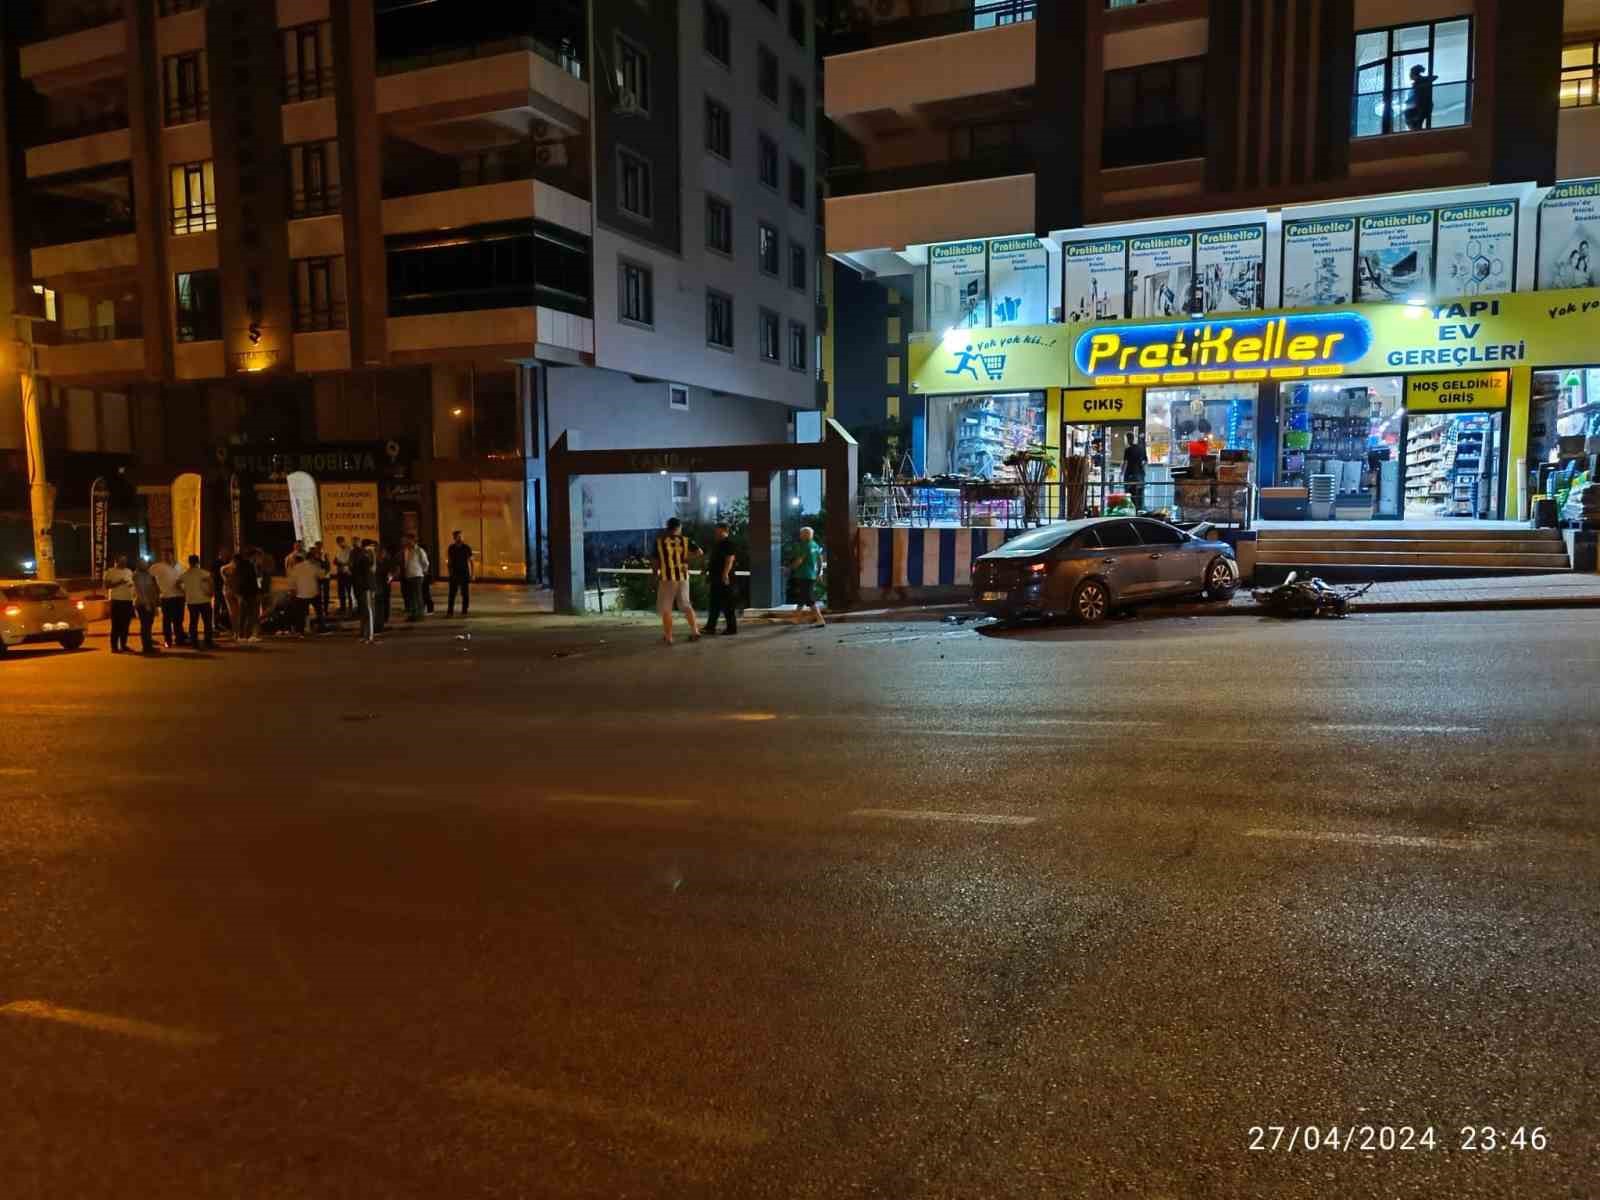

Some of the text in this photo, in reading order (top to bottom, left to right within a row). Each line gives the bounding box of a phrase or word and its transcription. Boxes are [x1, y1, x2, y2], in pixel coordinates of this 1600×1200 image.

[1444, 205, 1509, 220] Pratikeller
[1364, 213, 1428, 228] Pratikeller
[1290, 222, 1350, 235] Pratikeller
[1133, 236, 1188, 250] Pratikeller
[1202, 230, 1259, 243] Pratikeller
[935, 244, 982, 257] Pratikeller
[1069, 243, 1121, 256] Pratikeller
[1431, 300, 1500, 319] YAPI
[1438, 323, 1481, 341] EV
[1387, 340, 1525, 366] GEREÇLERİ
[1412, 376, 1503, 392] HOŞ GELDİNİZ
[1083, 398, 1124, 413] ÇIKIŞ
